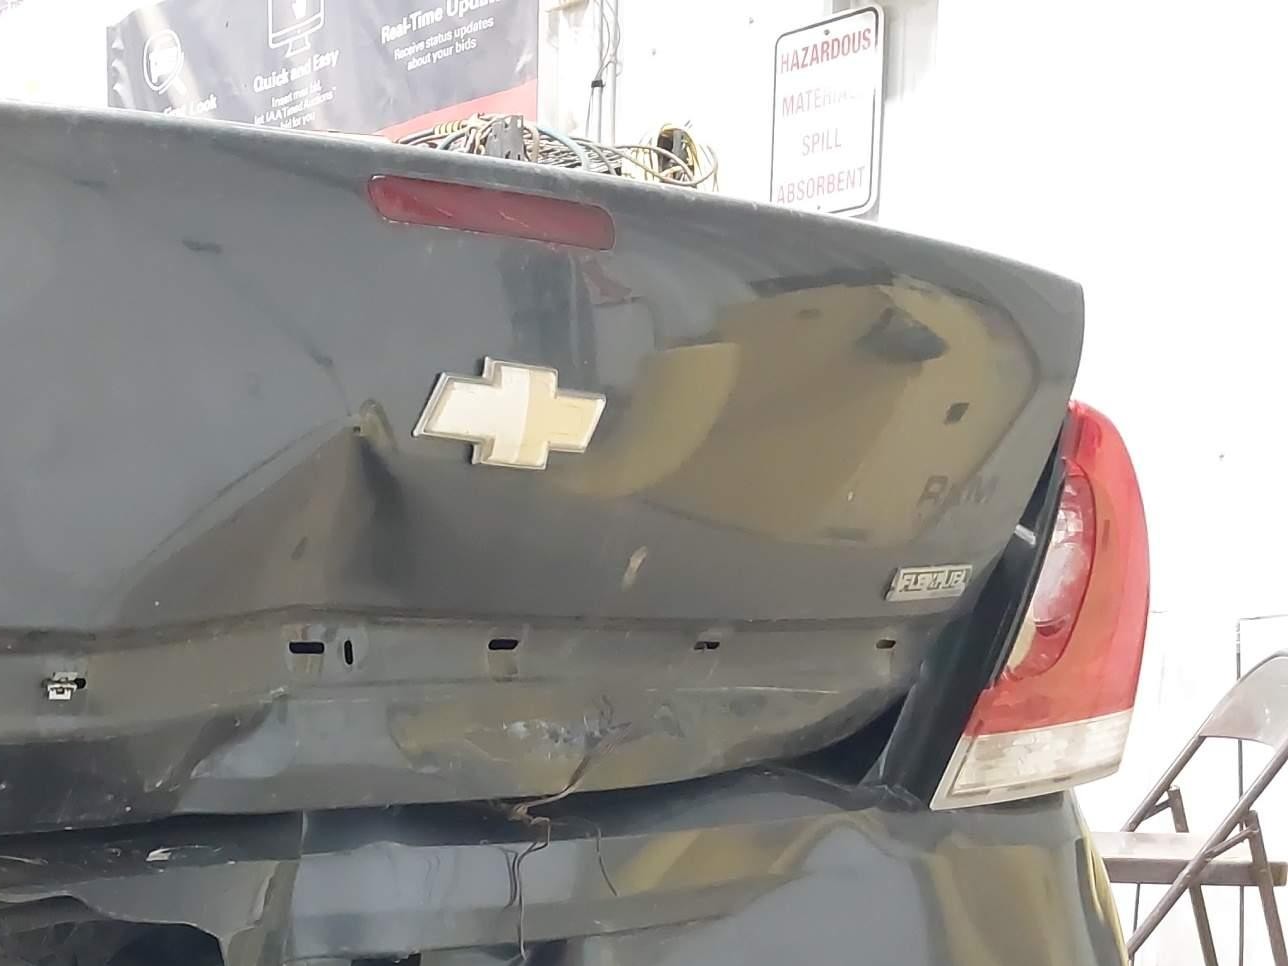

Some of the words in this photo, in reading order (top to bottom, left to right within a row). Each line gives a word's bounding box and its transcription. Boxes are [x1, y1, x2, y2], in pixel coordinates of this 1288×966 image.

[381, 8, 444, 45] Real-Time
[393, 40, 425, 61] Receive
[426, 31, 453, 49] status
[454, 17, 495, 40] updates
[408, 54, 431, 71] about
[432, 46, 454, 64] your
[455, 38, 477, 54] bids
[779, 27, 872, 74] HAZARDOUS
[253, 67, 289, 93] Quick
[290, 57, 312, 81] and
[313, 48, 340, 70] Easy
[801, 127, 842, 156] SPILL
[776, 166, 866, 205] ABSORBENT
